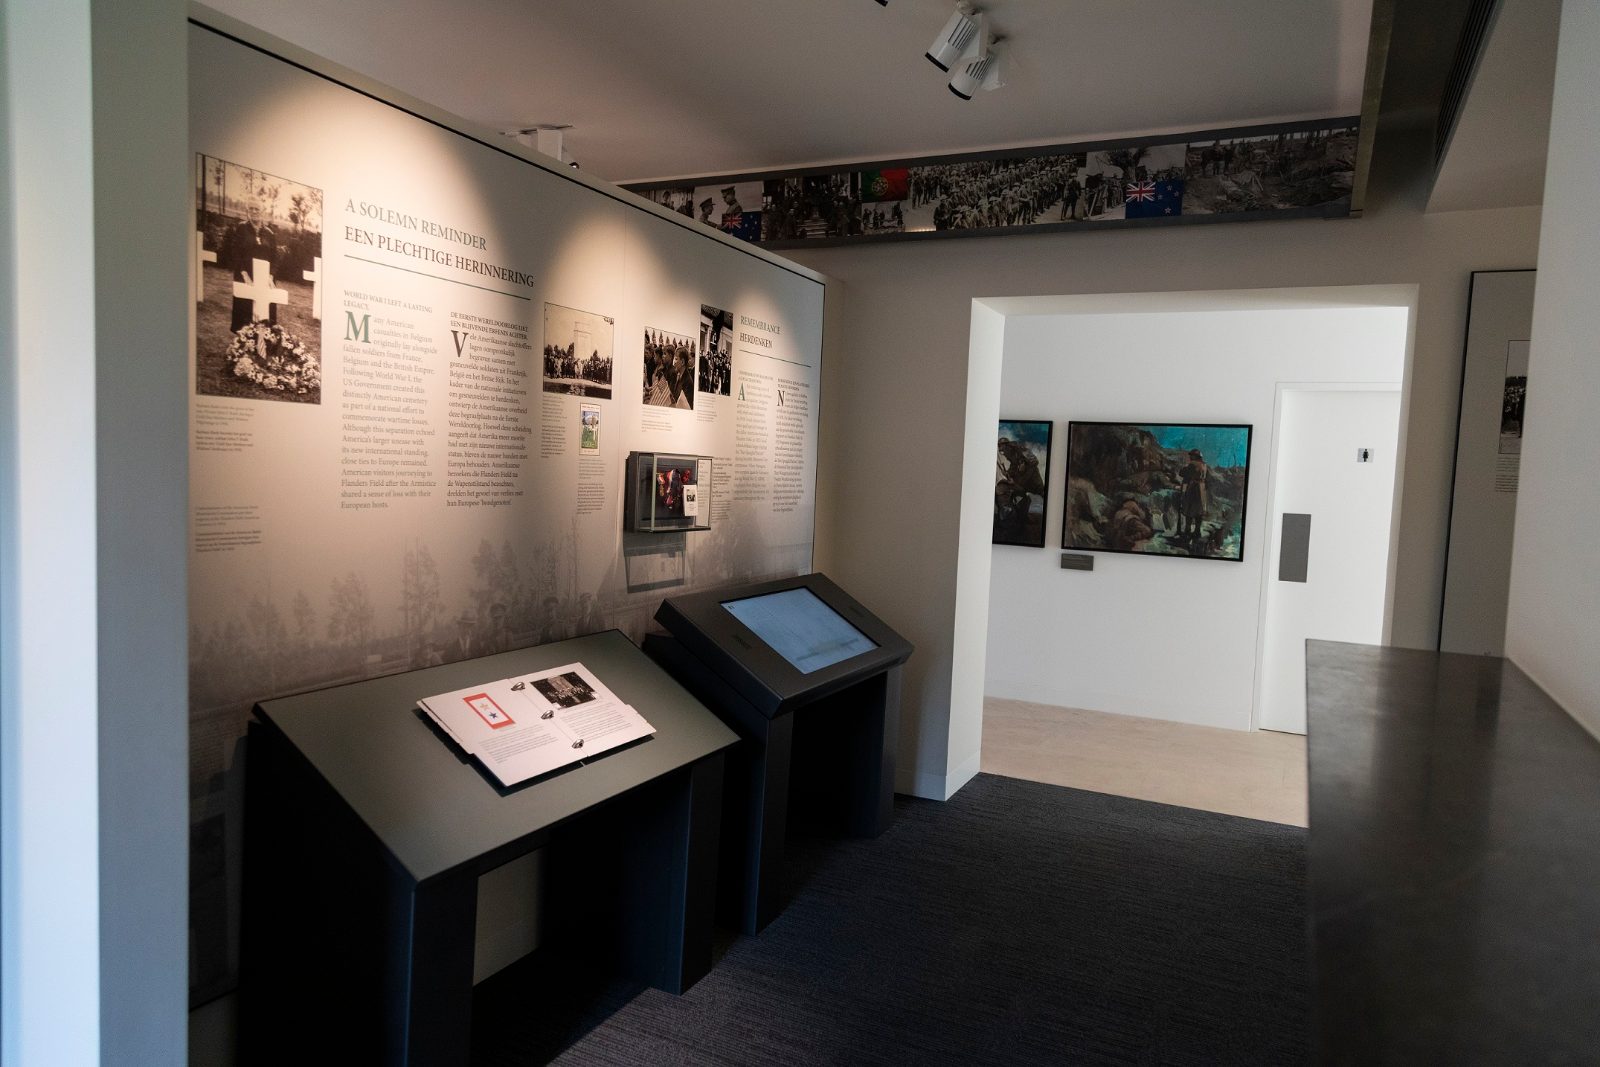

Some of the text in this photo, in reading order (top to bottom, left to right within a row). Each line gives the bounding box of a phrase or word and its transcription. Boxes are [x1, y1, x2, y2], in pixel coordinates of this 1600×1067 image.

[346, 198, 486, 250] A SOLEMN REMINDER
[345, 226, 534, 287] EEN PLECHTIGE HERINNERING
[344, 290, 368, 300] WORLD
[388, 298, 401, 307] LEFT
[344, 311, 371, 343] M
[740, 316, 780, 334] REMEMBRANCE
[451, 330, 468, 357] V
[740, 332, 772, 348] HERDENKEN
[375, 370, 393, 380] World
[343, 378, 353, 386] US
[354, 380, 391, 390] Government
[738, 382, 746, 401] A
[373, 393, 401, 402] American
[777, 390, 786, 406] N
